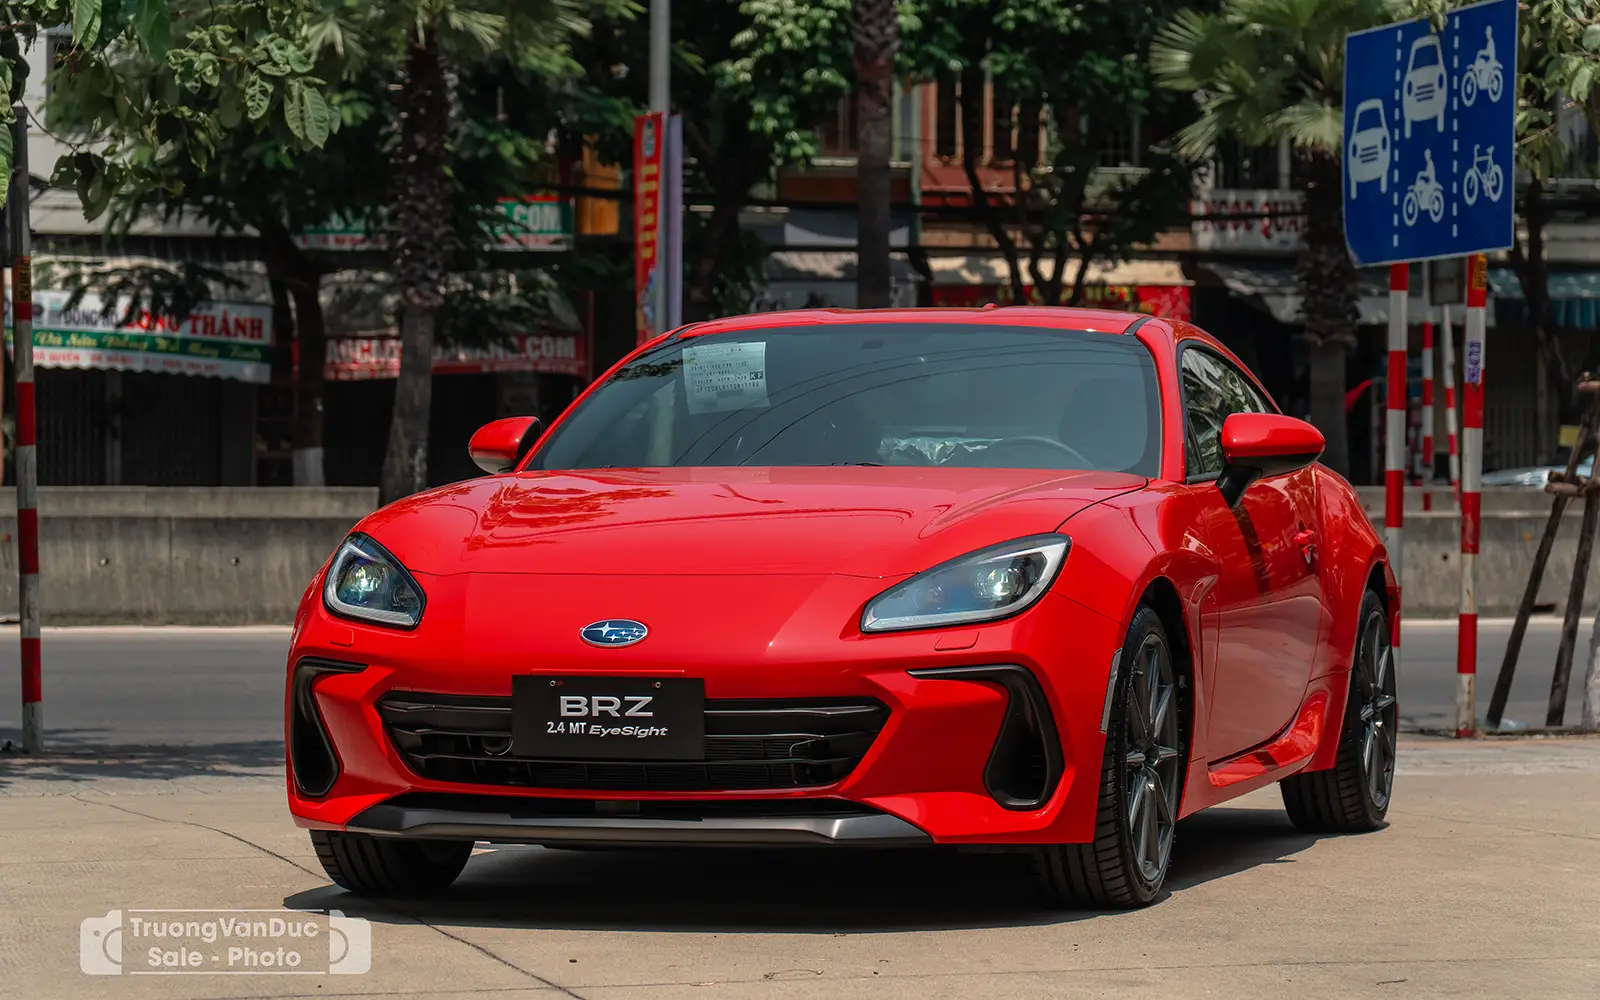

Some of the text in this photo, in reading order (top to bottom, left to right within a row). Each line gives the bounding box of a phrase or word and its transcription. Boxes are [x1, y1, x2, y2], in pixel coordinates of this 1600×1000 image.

[560, 696, 653, 717] BRZ
[547, 722, 668, 738] 2.4 MT EyeSight
